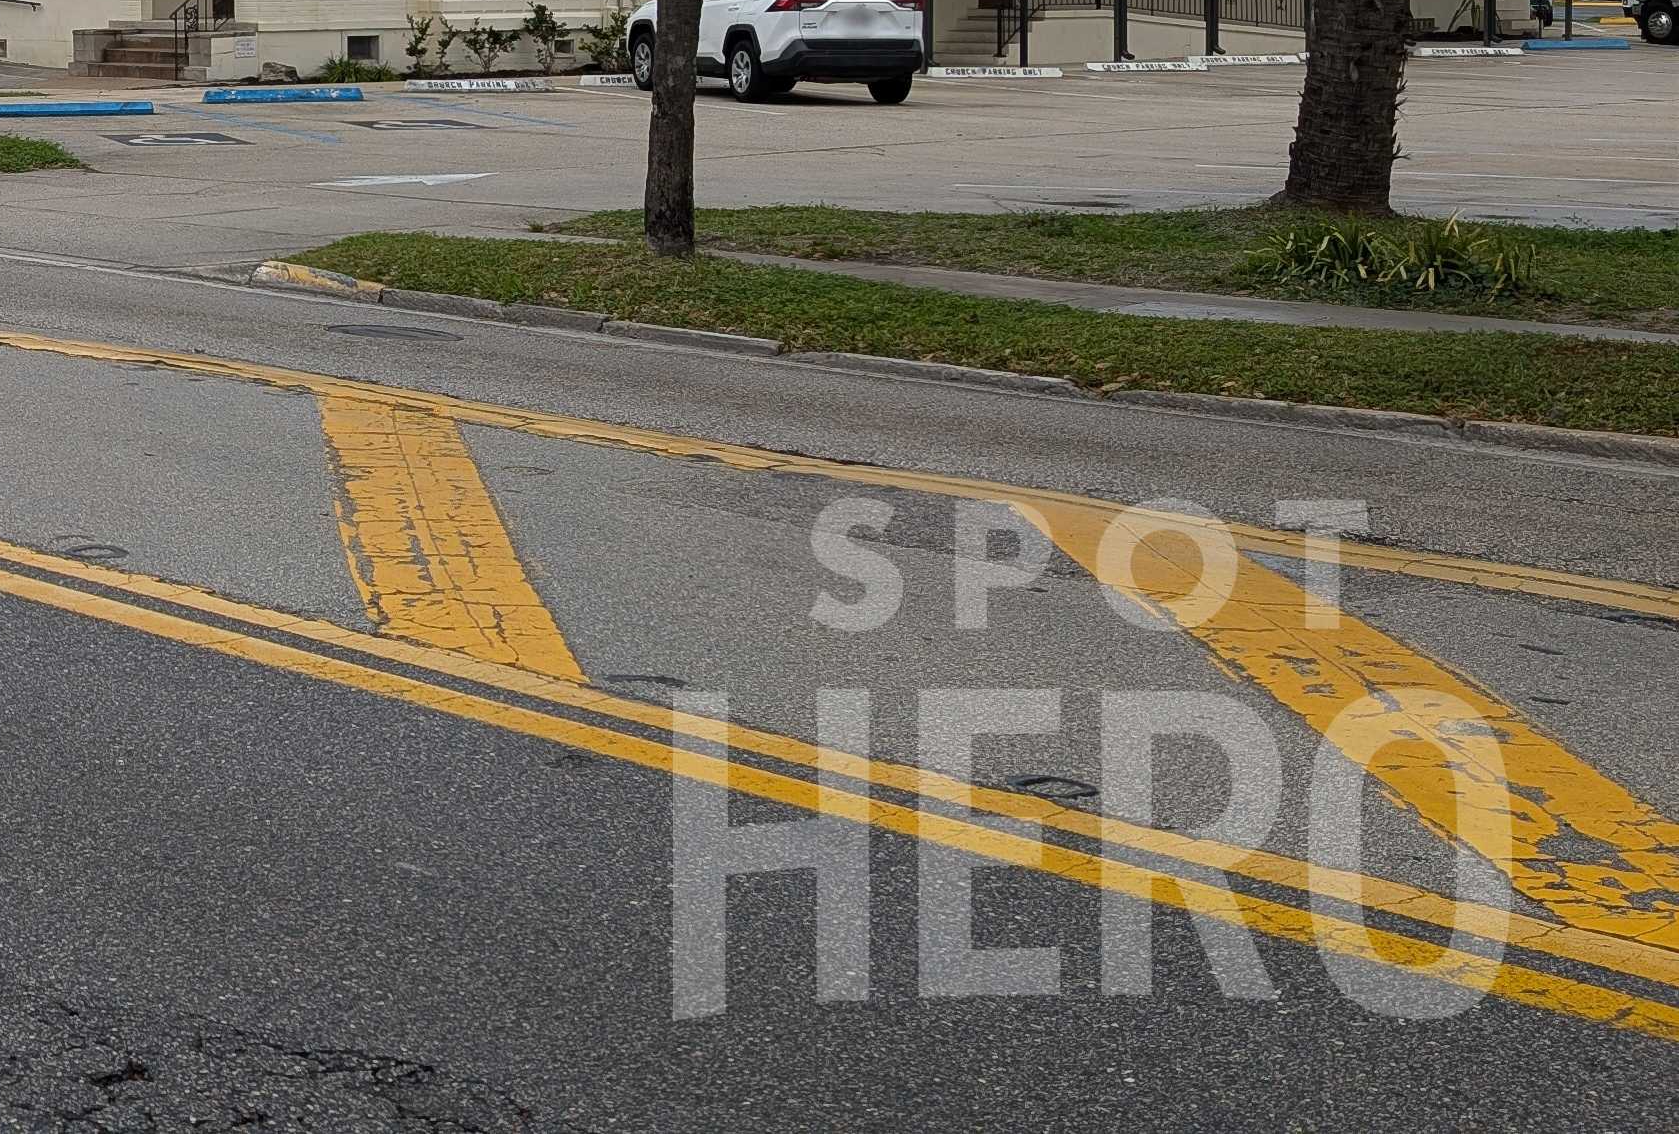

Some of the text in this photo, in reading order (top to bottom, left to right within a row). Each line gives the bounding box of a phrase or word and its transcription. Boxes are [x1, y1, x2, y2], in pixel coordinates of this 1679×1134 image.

[945, 67, 976, 76] CHURCH
[981, 67, 1017, 76] PARKING
[600, 76, 632, 85] CHURCH
